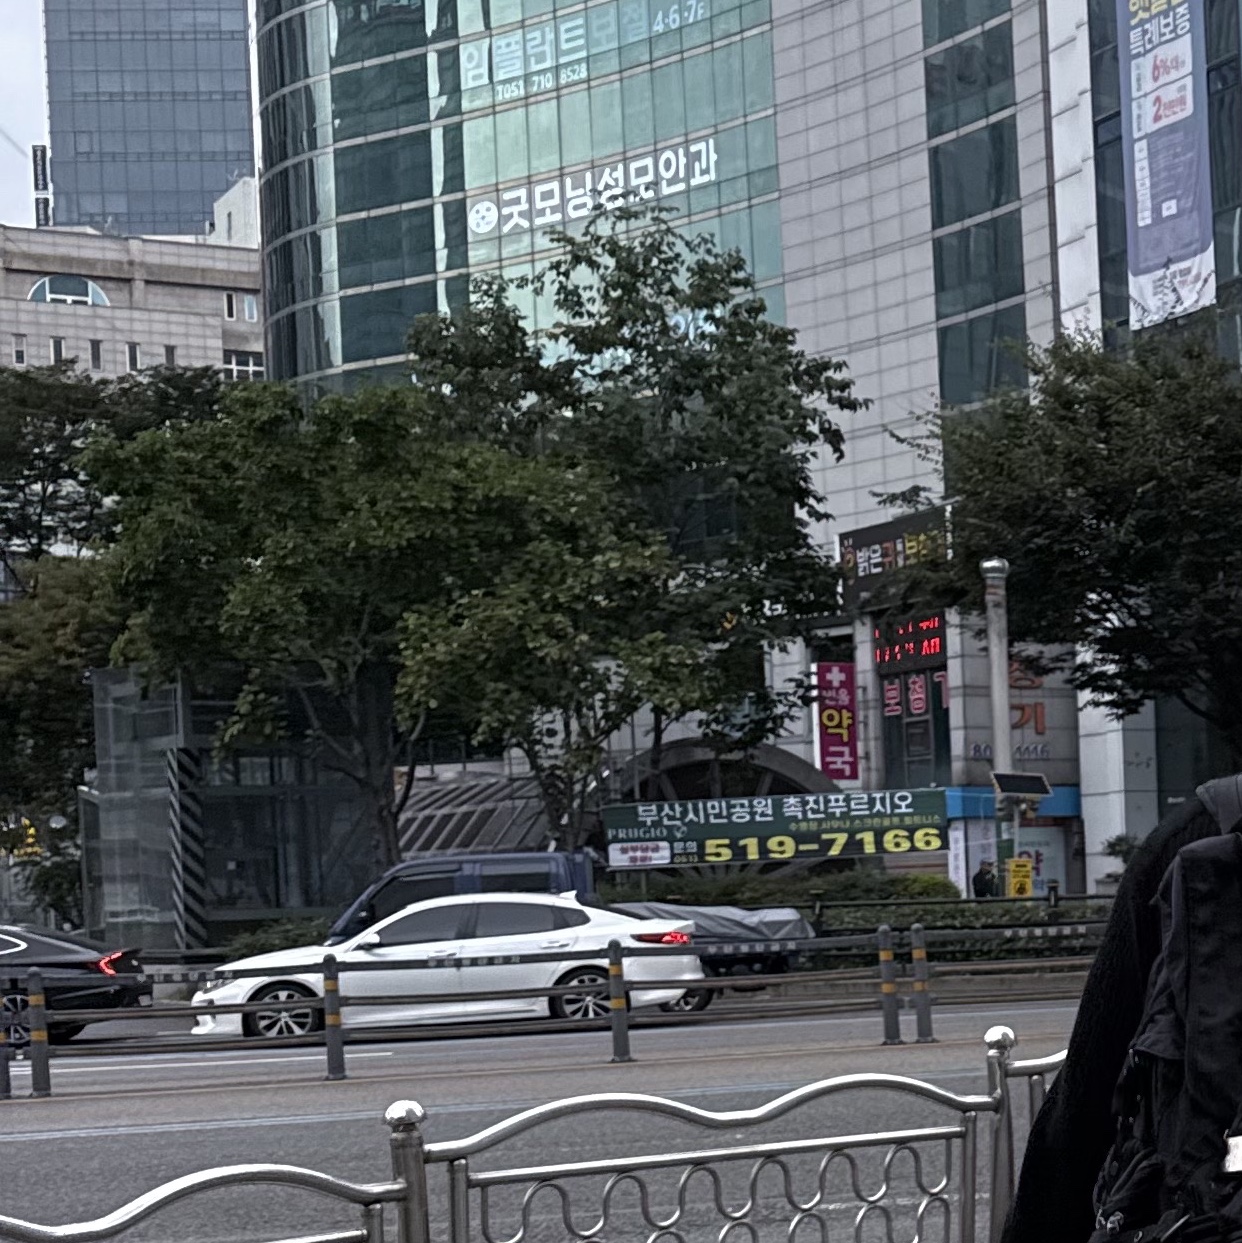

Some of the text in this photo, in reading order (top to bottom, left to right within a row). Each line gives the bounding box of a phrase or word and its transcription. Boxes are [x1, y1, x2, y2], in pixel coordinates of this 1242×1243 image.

[1129, 3, 1191, 55] 특례보증
[532, 73, 553, 92] 710
[502, 138, 717, 233] 굿모닝성모안과
[821, 708, 854, 776] 약국
[637, 792, 914, 827] 부산시민공원 촉진푸르지오
[608, 827, 668, 839] PRUGIO
[704, 828, 943, 862] 519-7166
